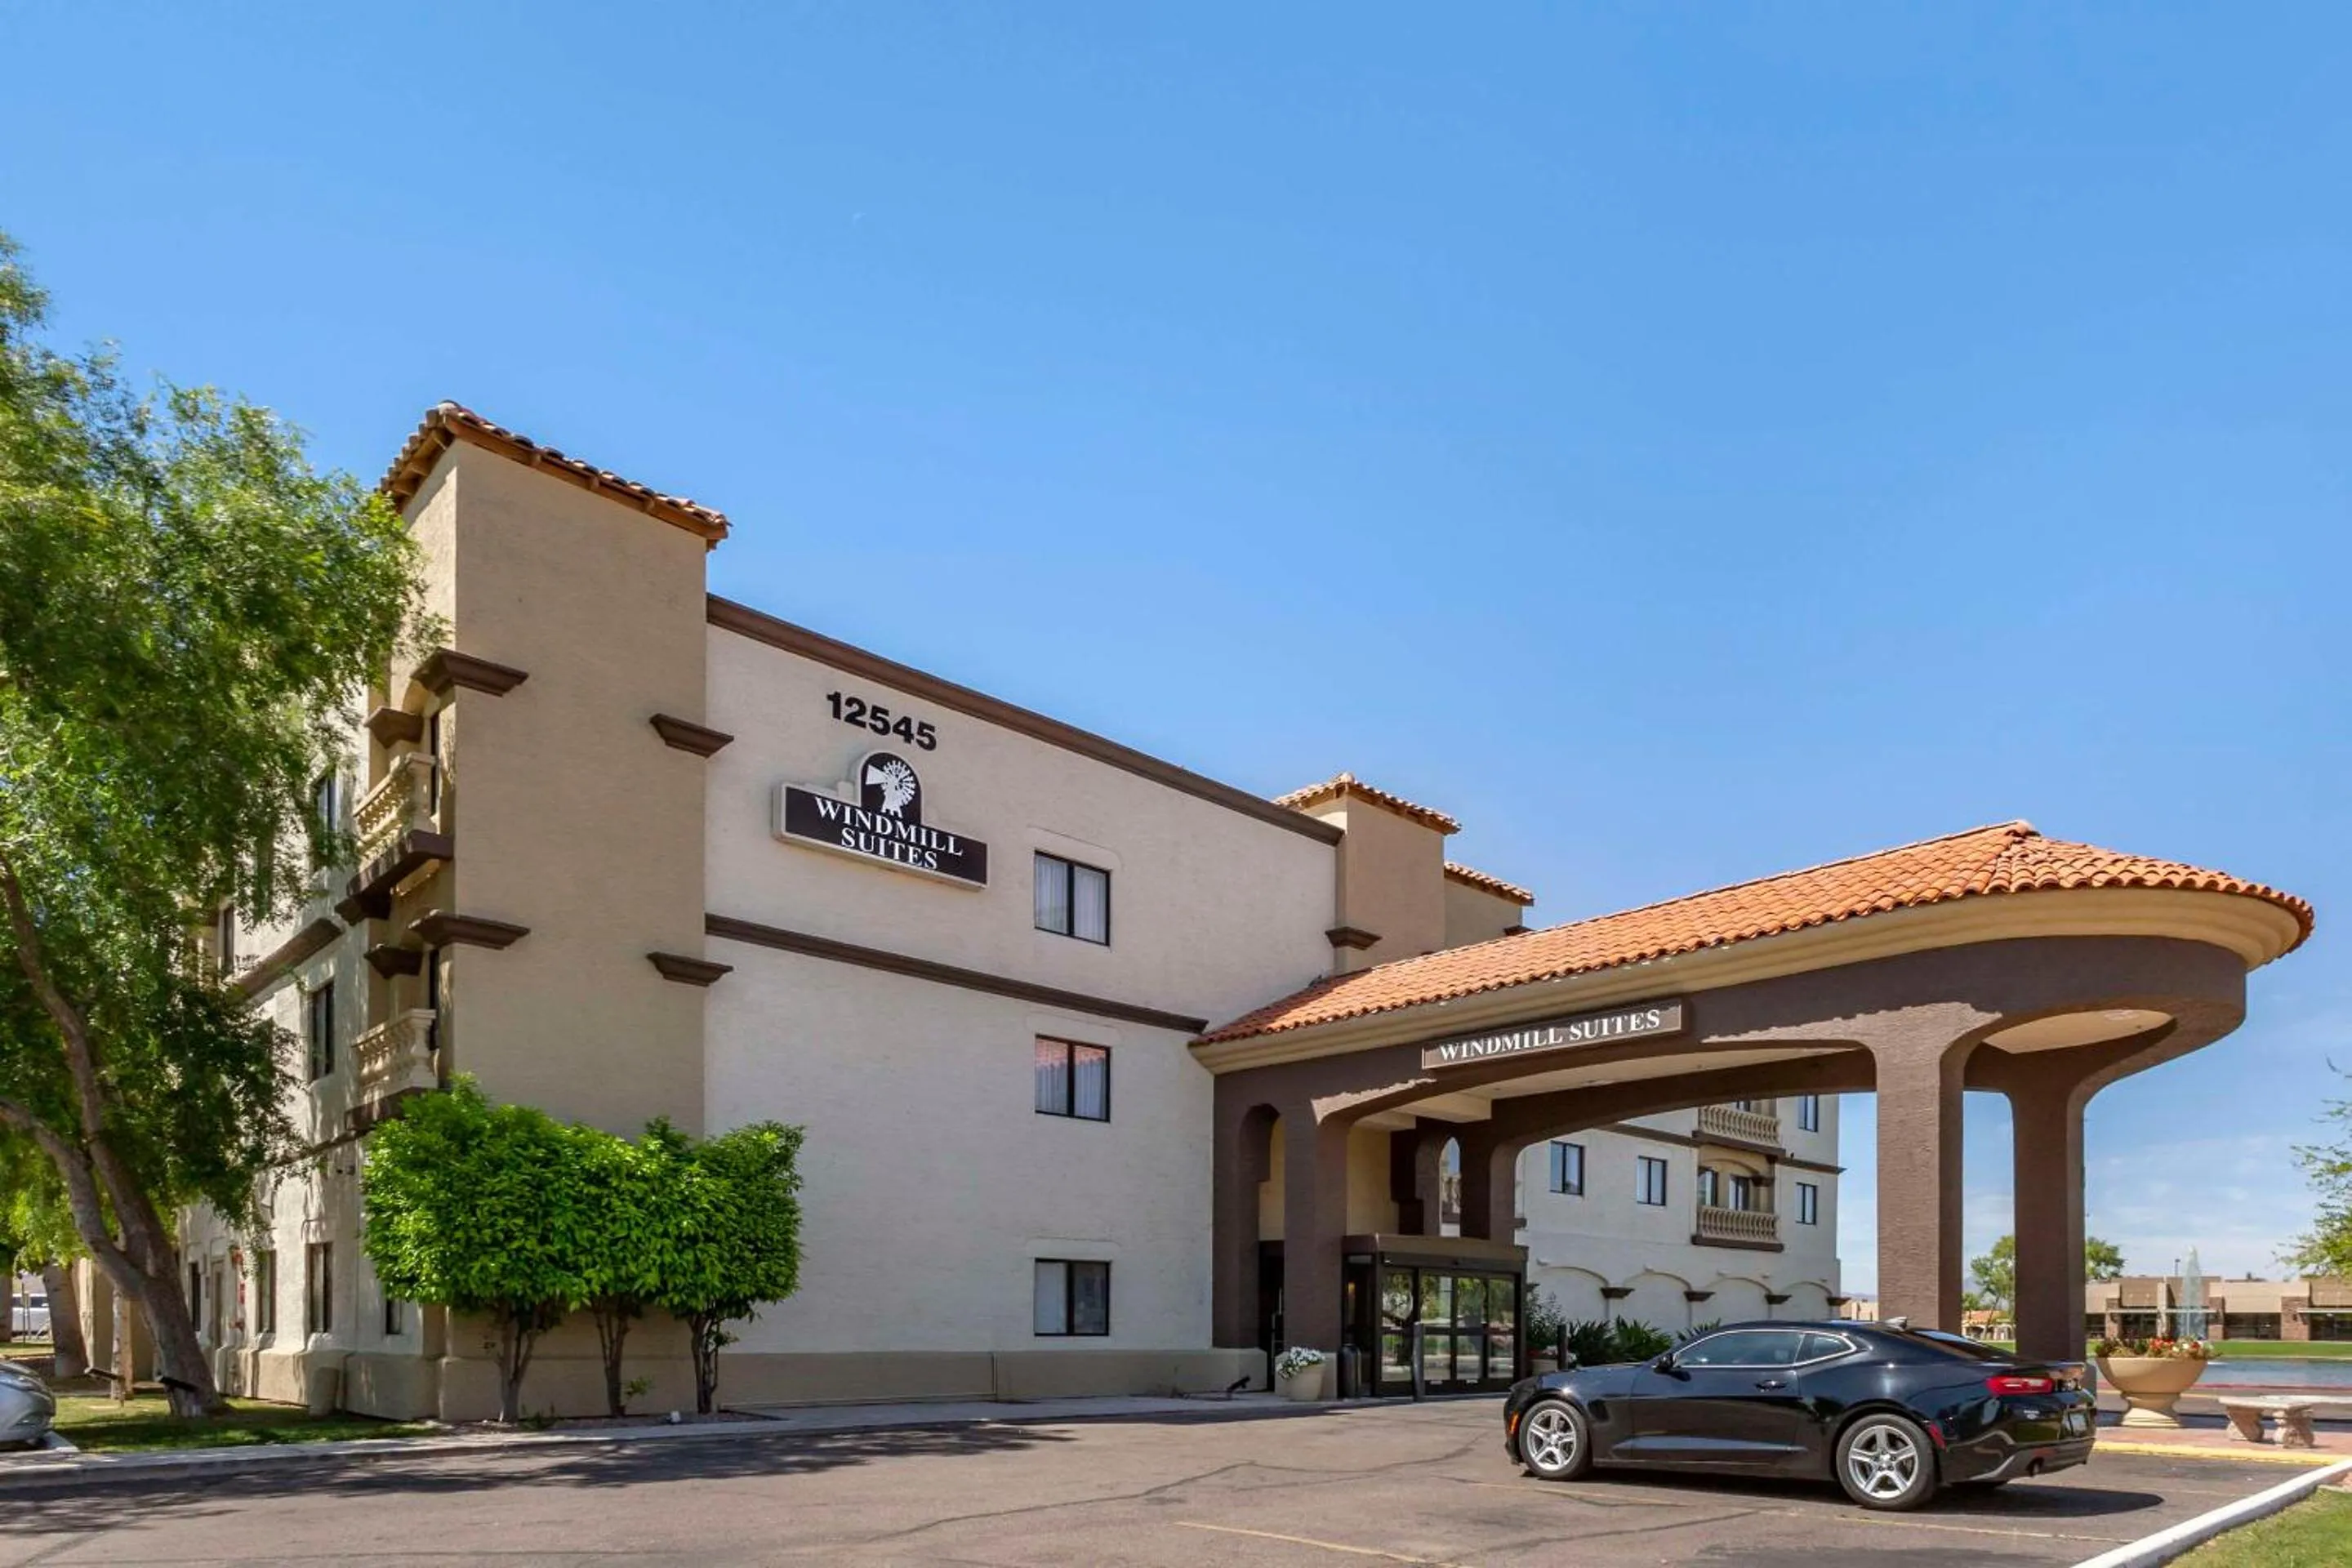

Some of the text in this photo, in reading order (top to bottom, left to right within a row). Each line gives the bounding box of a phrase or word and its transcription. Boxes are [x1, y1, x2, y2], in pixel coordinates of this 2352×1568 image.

[826, 691, 937, 751] 12545
[815, 796, 964, 856] WINDMILL
[841, 826, 938, 870] SUITES
[1440, 1009, 1660, 1062] WINDMILL SUITES
